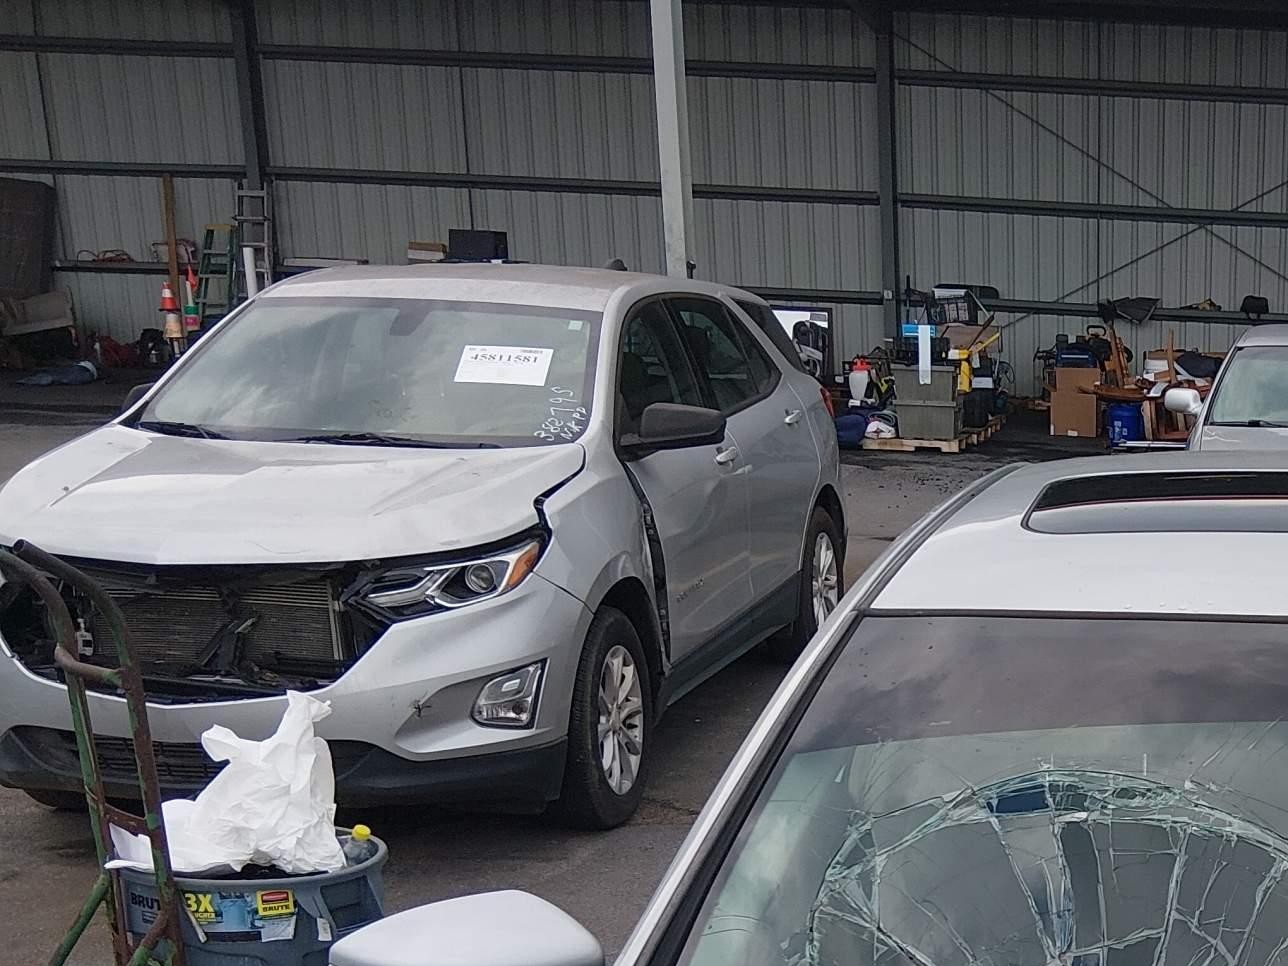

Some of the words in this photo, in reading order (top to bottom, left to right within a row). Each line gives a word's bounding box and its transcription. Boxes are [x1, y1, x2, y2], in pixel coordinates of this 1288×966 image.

[131, 891, 161, 911] BRUT
[185, 893, 214, 913] 3X
[262, 904, 290, 912] BRUTE
